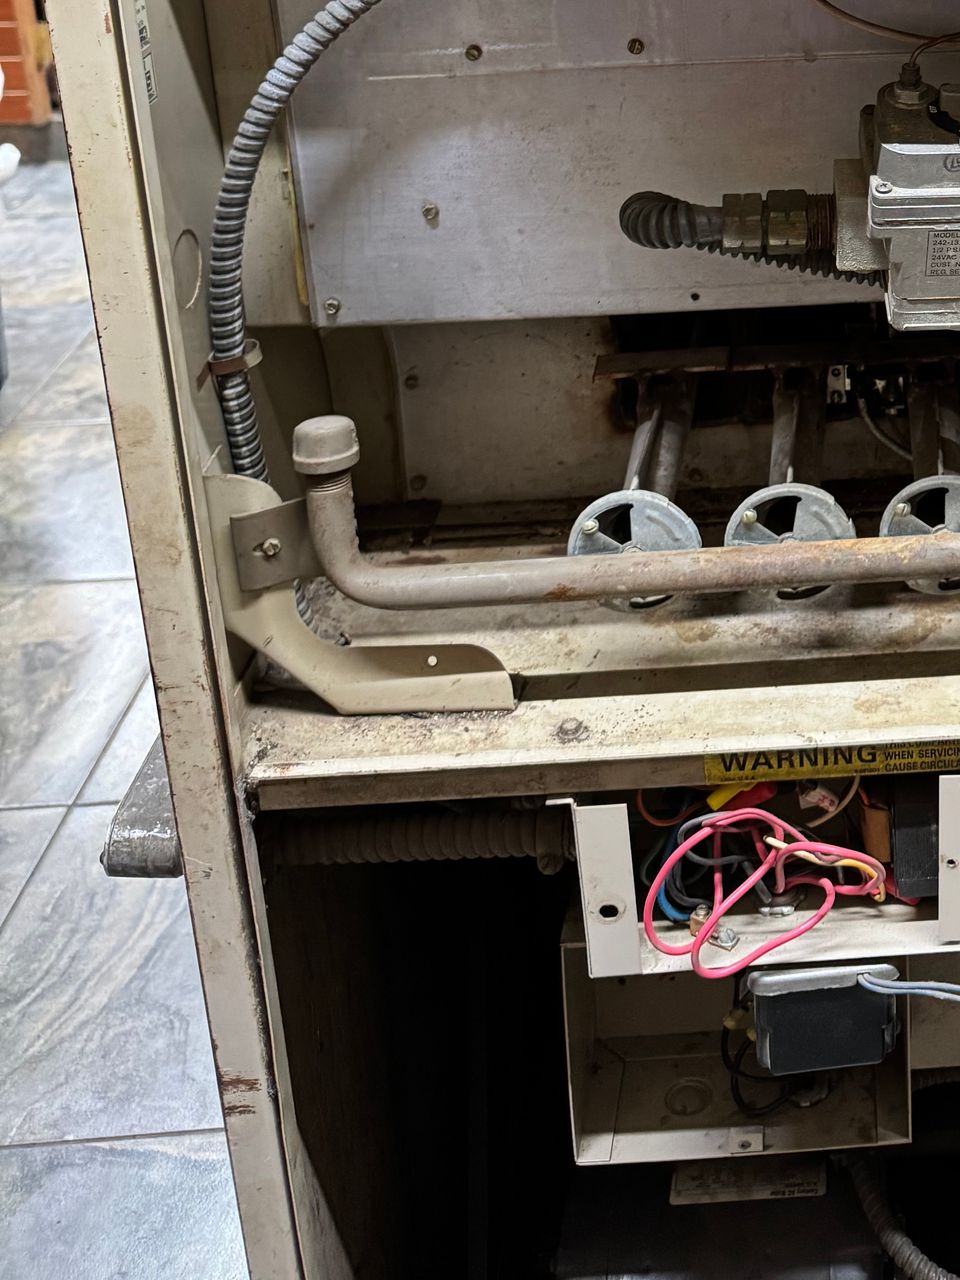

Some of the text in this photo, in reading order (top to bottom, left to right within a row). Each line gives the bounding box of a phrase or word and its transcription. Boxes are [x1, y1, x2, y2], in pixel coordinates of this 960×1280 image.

[719, 745, 878, 773] WARNING
[884, 750, 914, 761] WHEN
[884, 761, 919, 773] CAUSE
